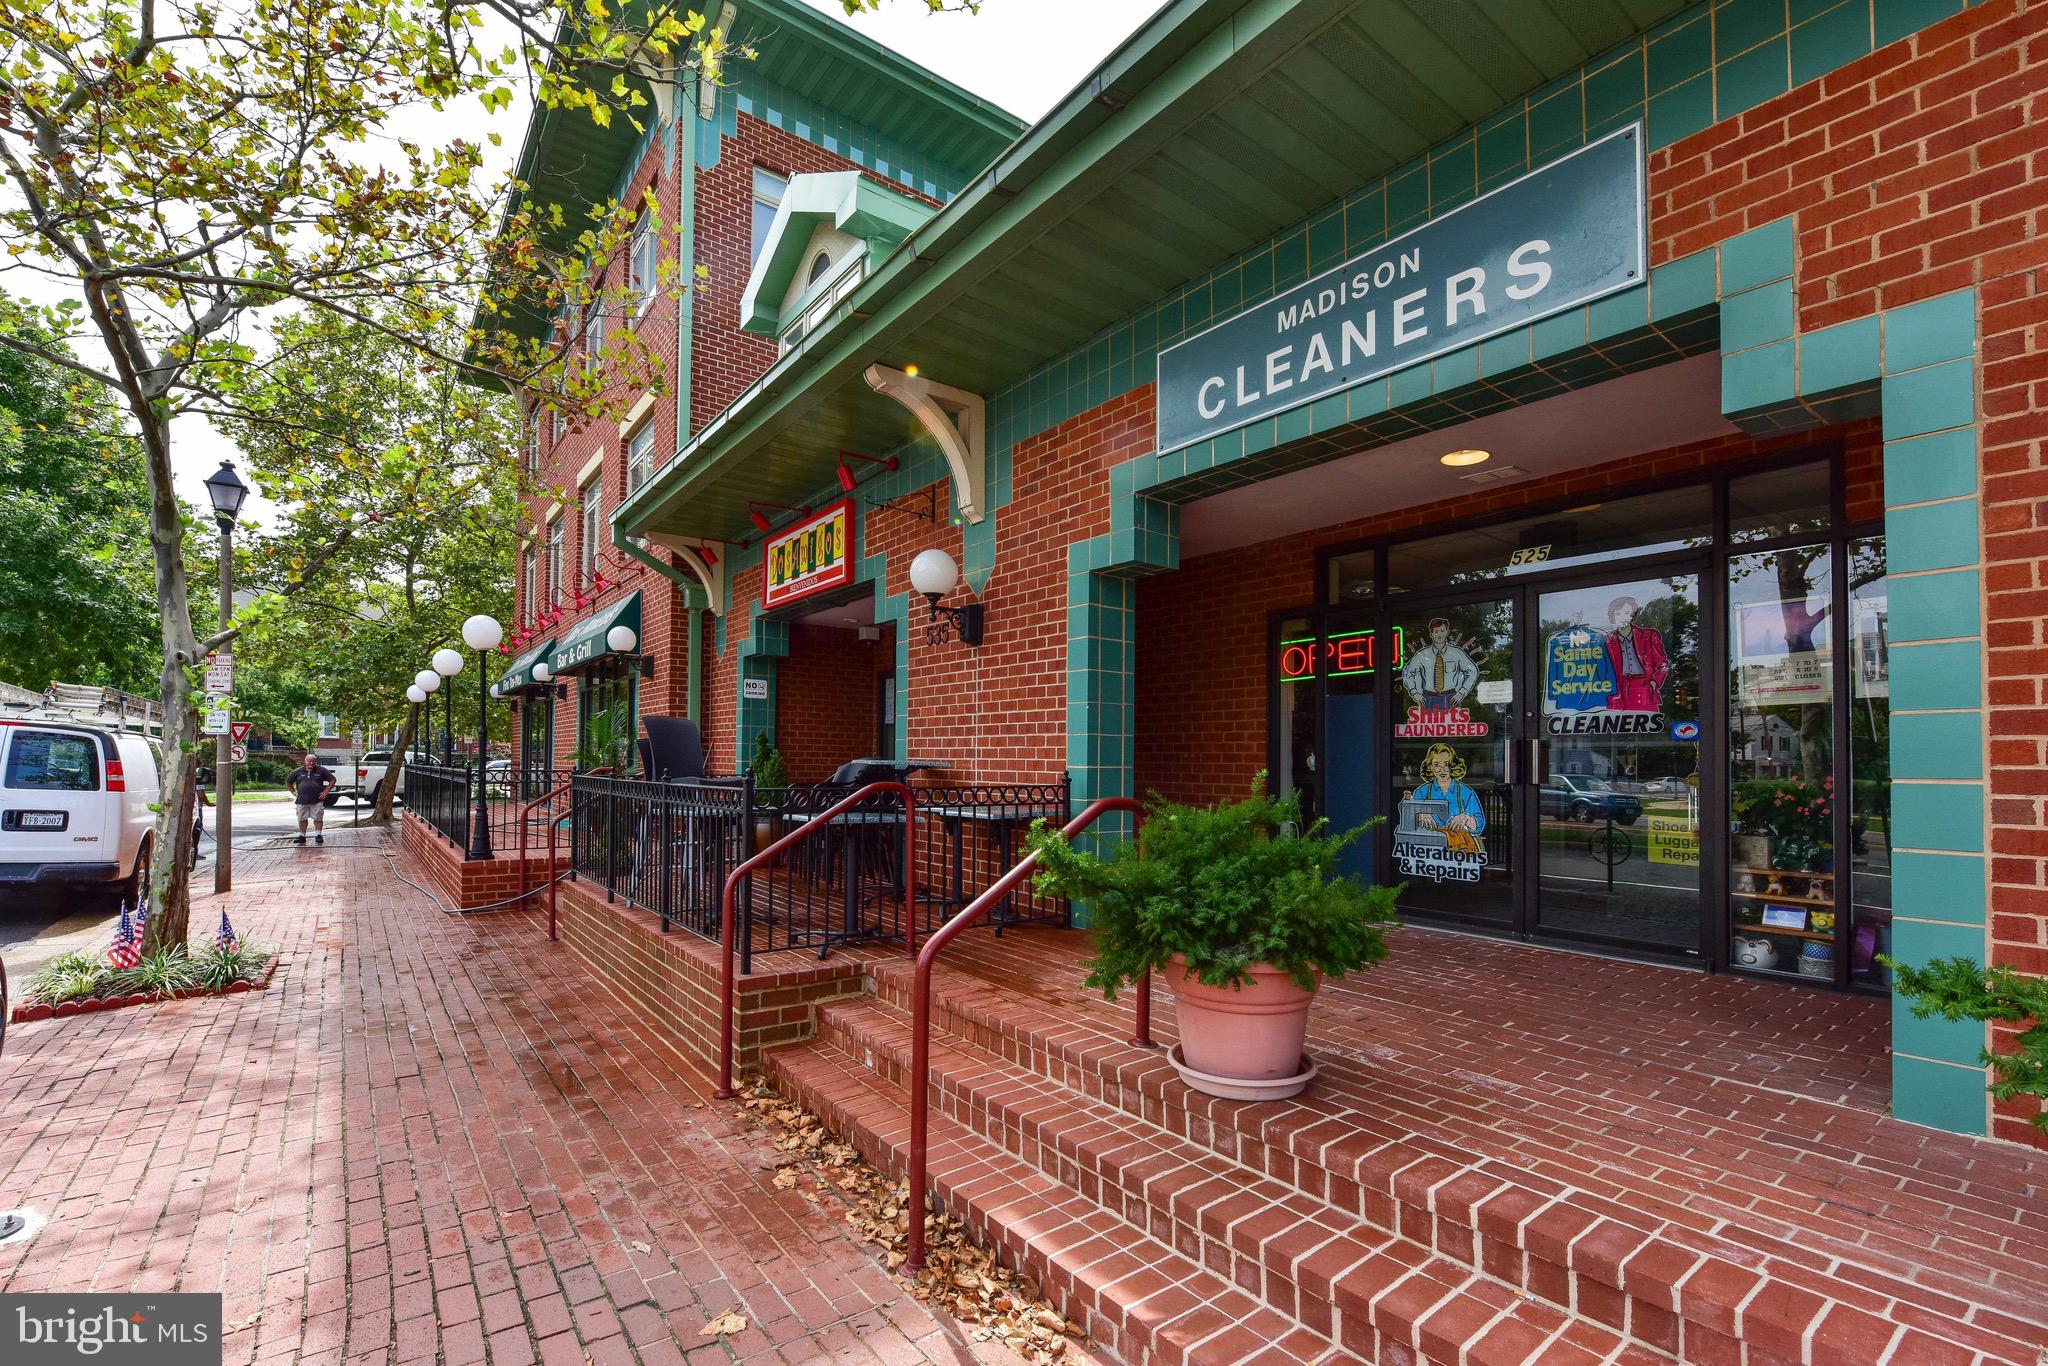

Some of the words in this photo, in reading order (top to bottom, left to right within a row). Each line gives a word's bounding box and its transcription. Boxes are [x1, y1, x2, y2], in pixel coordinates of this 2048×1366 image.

[1277, 247, 1422, 334] MADISON
[1196, 239, 1553, 420] CLEANERS
[1511, 546, 1550, 565] 525
[206, 656, 216, 665] NO
[557, 653, 568, 669] Bar
[568, 647, 576, 665] &
[576, 639, 592, 661] Grill
[1553, 645, 1603, 663] Same
[1563, 661, 1598, 681] Day
[1552, 679, 1613, 696] Service
[1408, 704, 1470, 725] Shirts
[1548, 713, 1665, 735] CLEANERS
[1395, 723, 1489, 737] LAUNDERED
[24, 816, 62, 825] YFB-2007
[1655, 833, 1700, 849] Lugga
[1393, 841, 1487, 865] Alterations
[1662, 848, 1700, 862] Repa
[1400, 858, 1413, 874] &
[1415, 859, 1480, 882] Repairs
